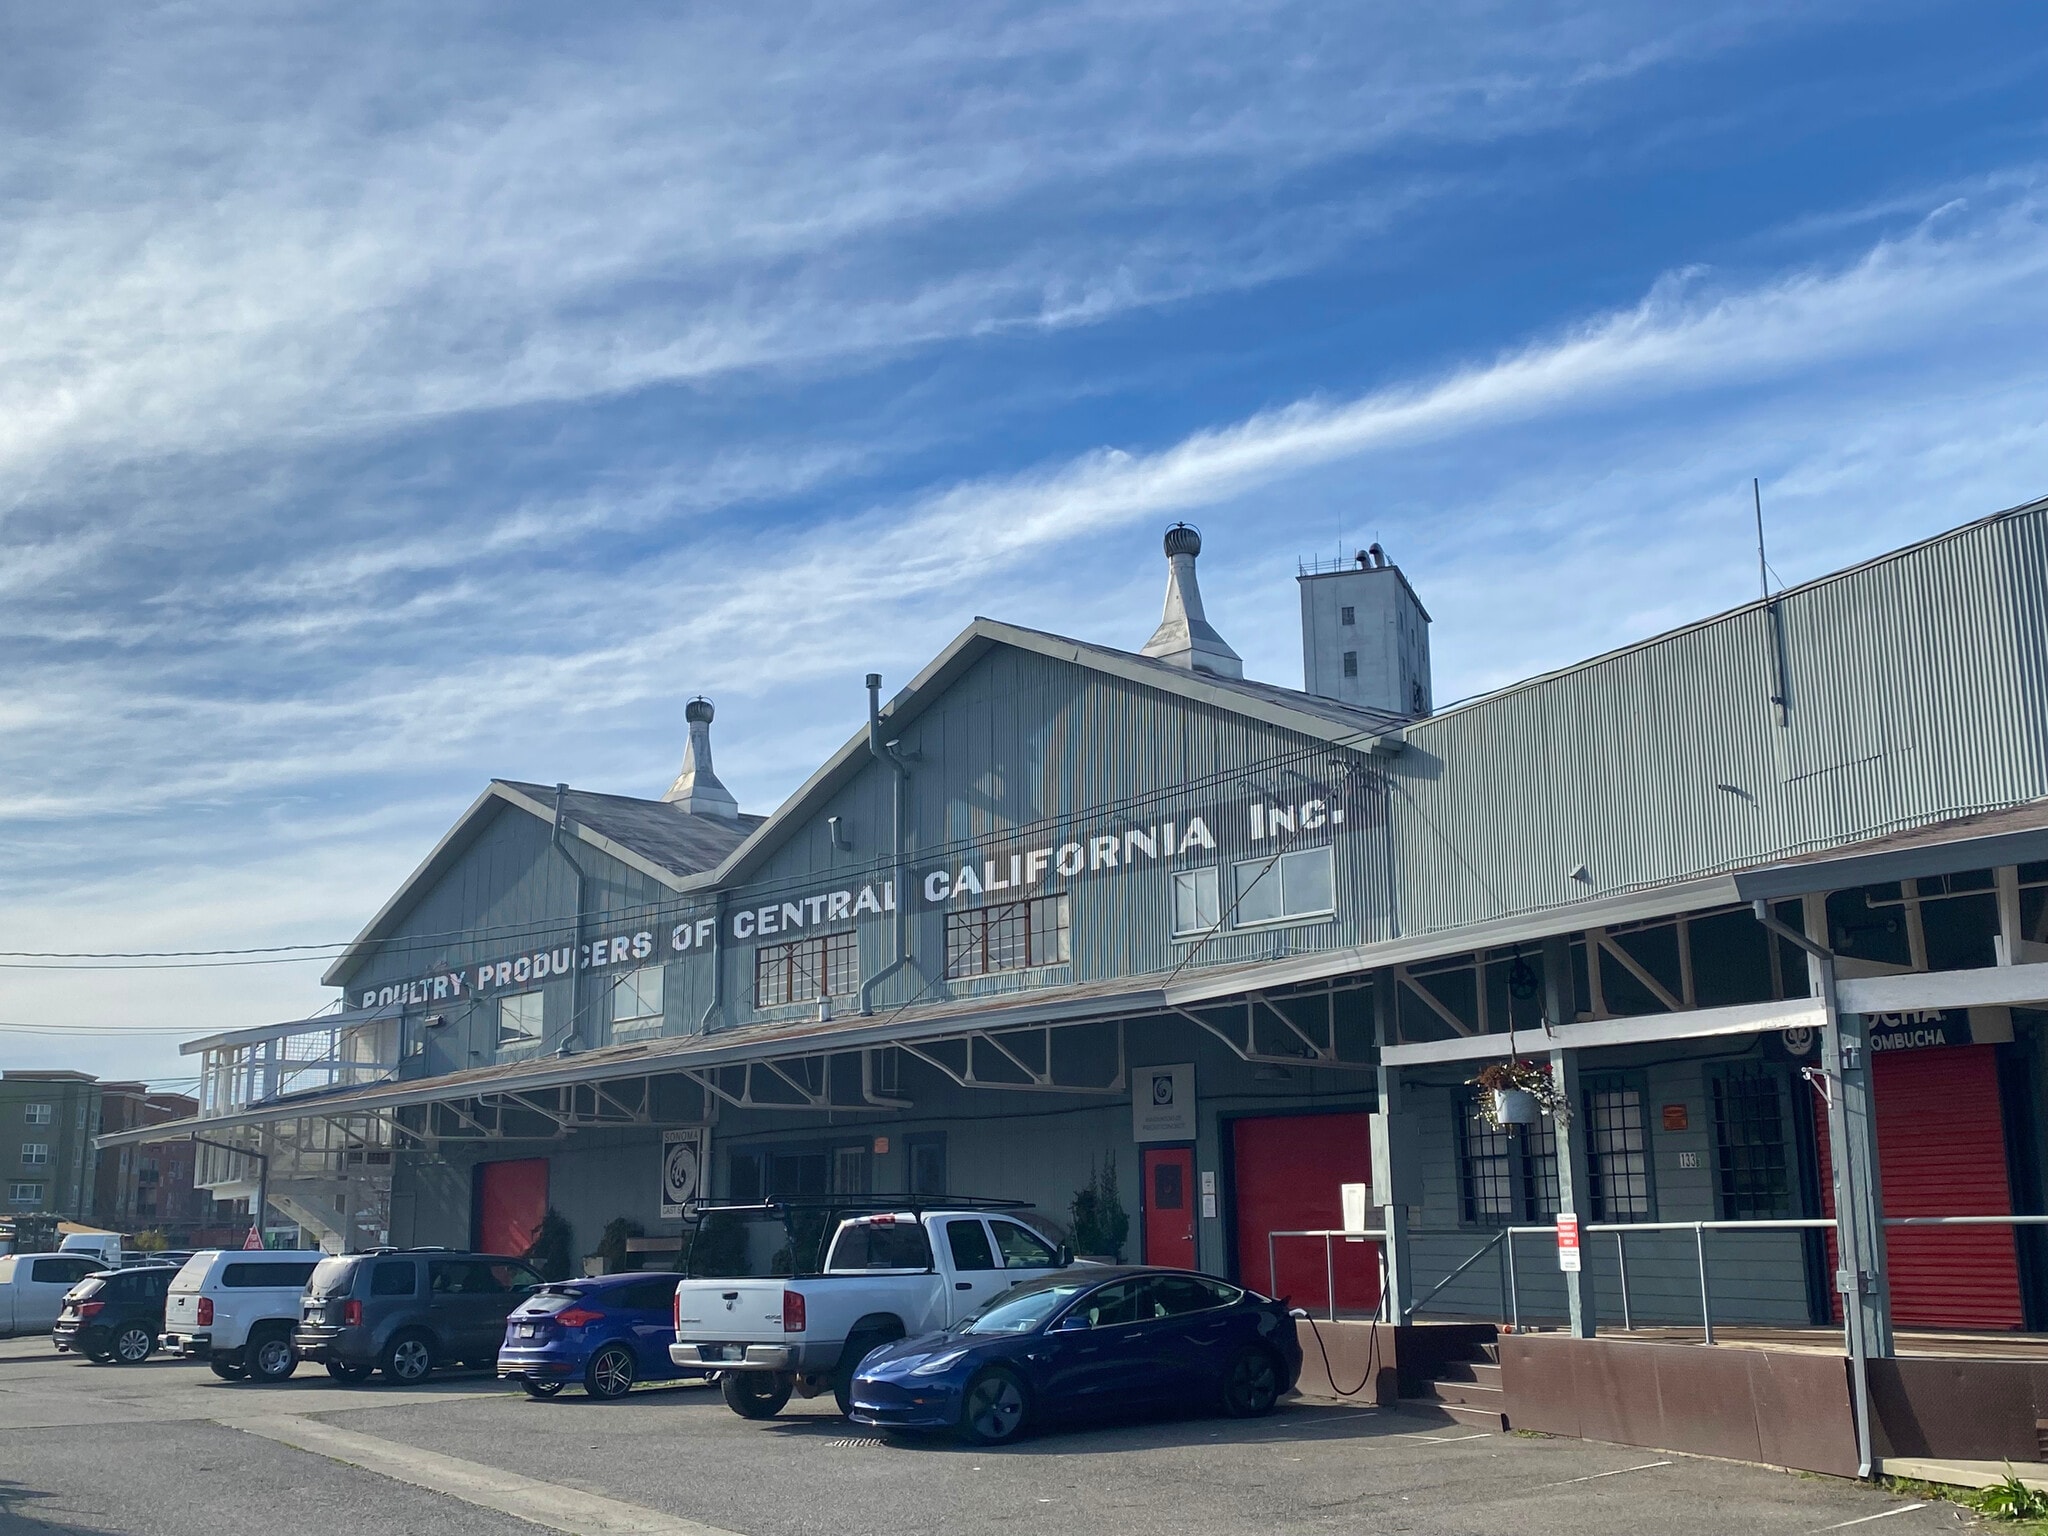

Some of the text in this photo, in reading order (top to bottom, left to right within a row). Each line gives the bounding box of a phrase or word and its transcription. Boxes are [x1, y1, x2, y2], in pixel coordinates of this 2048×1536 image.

[362, 971, 466, 1009] POULTRY
[478, 931, 652, 990] PRODUCERS
[672, 917, 716, 951] OF
[733, 881, 896, 939] CENTRAL
[924, 816, 1217, 902] CALIFORNIA
[1871, 1029, 1947, 1051] OMBUCHA
[664, 1130, 698, 1142] SONOMA
